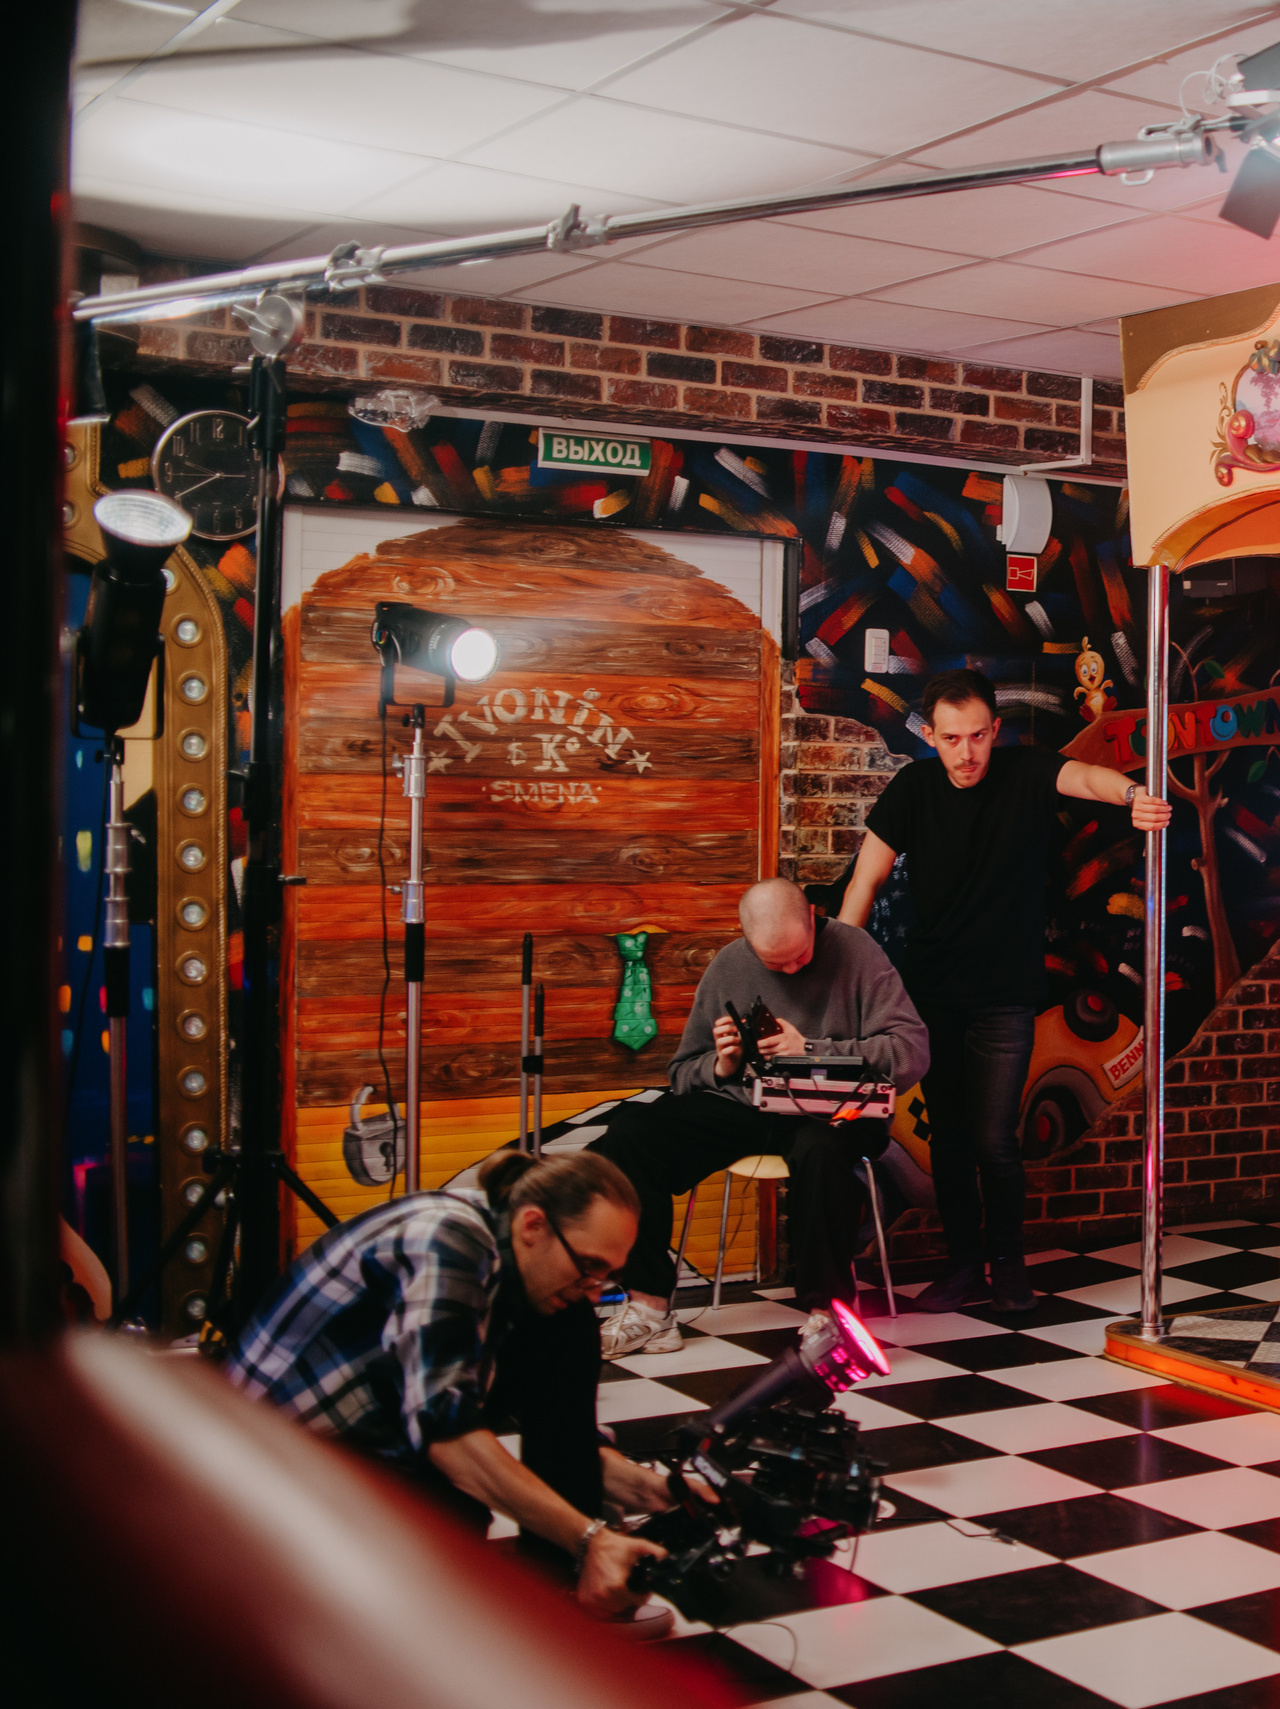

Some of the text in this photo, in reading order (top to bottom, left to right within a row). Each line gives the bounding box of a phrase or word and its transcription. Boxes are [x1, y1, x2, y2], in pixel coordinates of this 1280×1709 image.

[212, 418, 224, 439] 12
[552, 437, 641, 467] ВЫХОД
[1109, 1037, 1144, 1081] BENN
